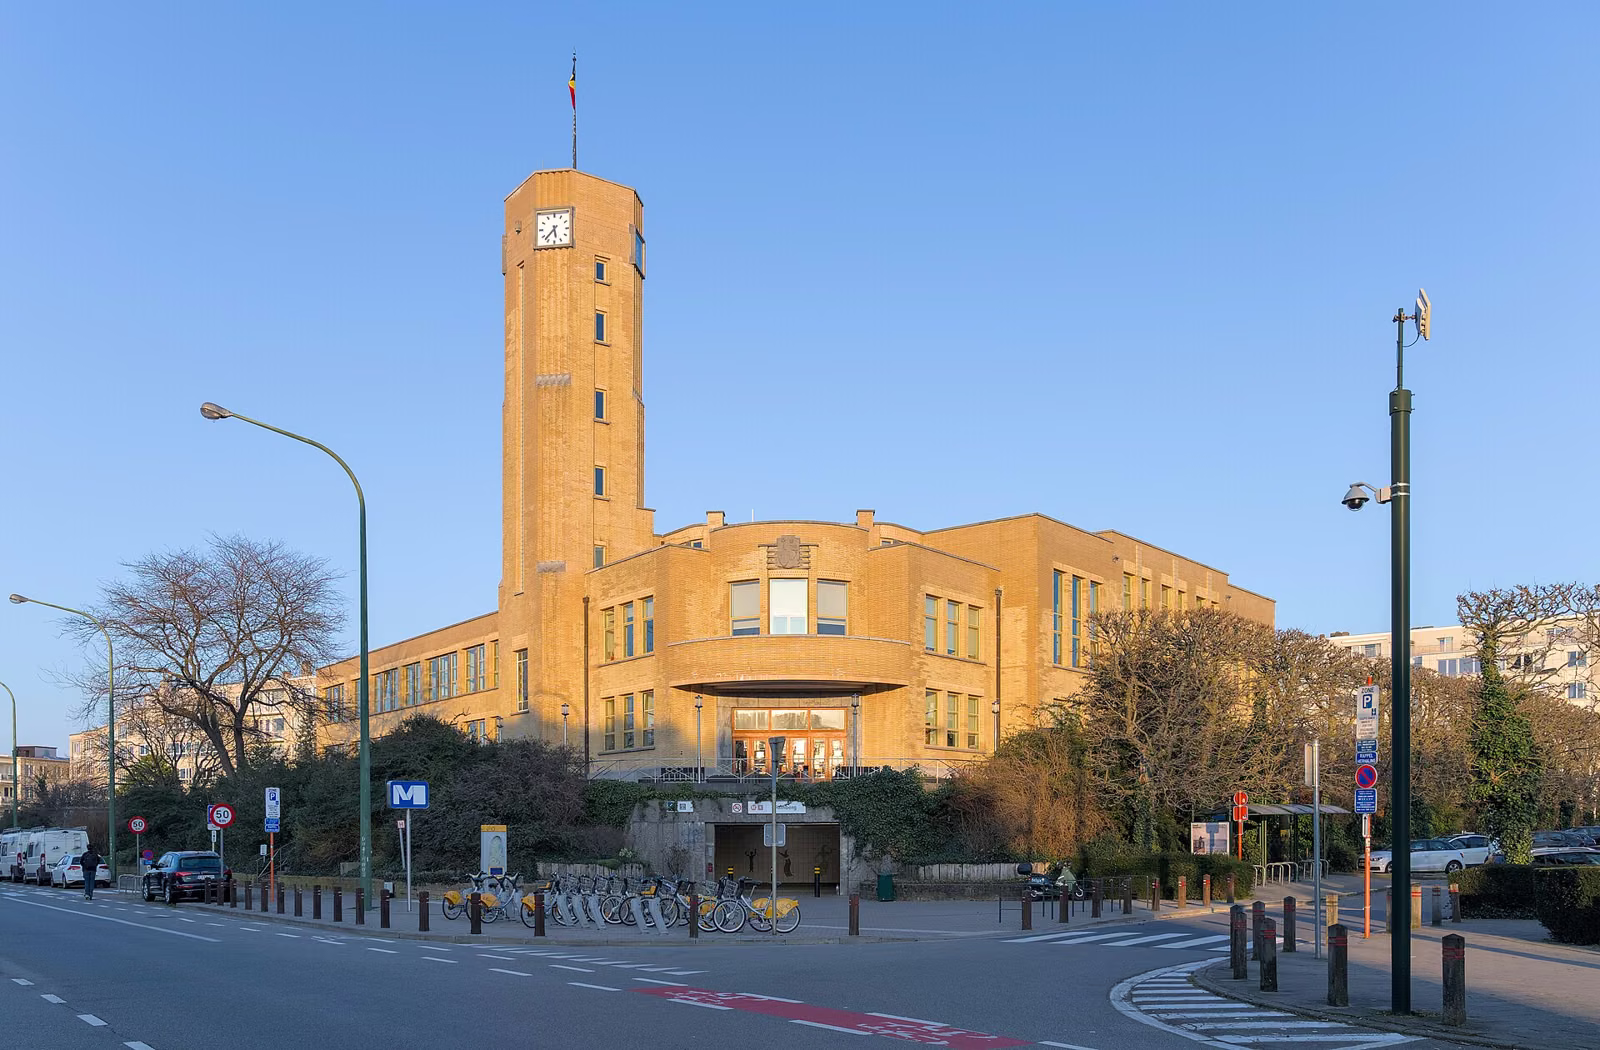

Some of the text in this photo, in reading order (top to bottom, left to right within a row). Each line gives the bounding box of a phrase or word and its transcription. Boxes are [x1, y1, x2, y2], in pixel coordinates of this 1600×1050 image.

[1363, 695, 1371, 707] P
[393, 784, 426, 805] M
[216, 810, 229, 819] 50
